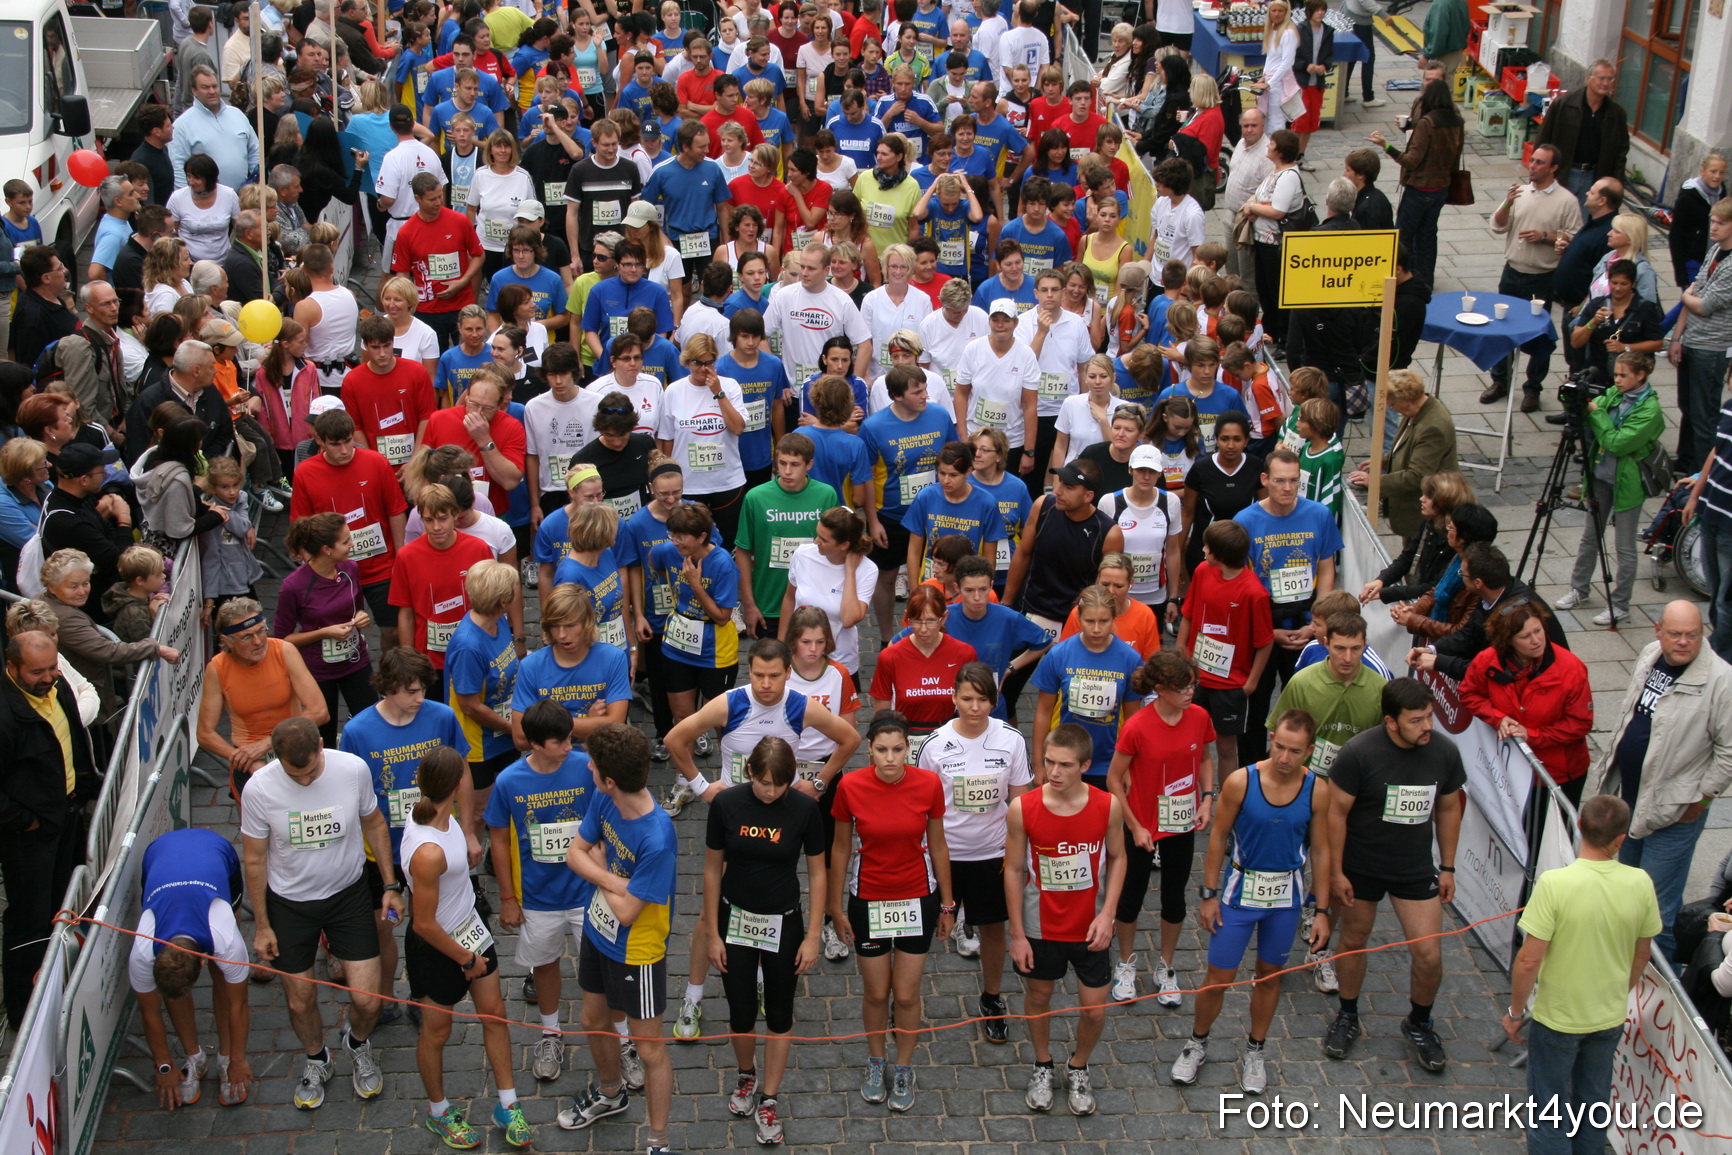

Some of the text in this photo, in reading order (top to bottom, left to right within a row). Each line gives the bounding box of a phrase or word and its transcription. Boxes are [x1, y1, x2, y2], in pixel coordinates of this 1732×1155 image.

[840, 140, 870, 150] HUBER
[600, 209, 619, 218] 5227
[874, 212, 892, 220] 5180
[688, 240, 709, 250] 5145
[438, 263, 458, 272] 5052
[1290, 254, 1387, 270] Schnupper-
[1322, 274, 1354, 288] lauf
[790, 310, 824, 319] GERHART
[1048, 382, 1068, 391] 5174
[749, 412, 763, 421] 167
[984, 410, 1006, 420] 5239
[679, 418, 718, 426] GERHART
[898, 431, 941, 445] NEUMARKTER
[389, 445, 412, 455] 5083
[898, 439, 934, 450] STADTLAUF
[700, 452, 723, 462] 5178
[614, 499, 631, 507] Martin
[618, 504, 640, 518] 5221
[766, 508, 821, 524] Sinupret
[934, 520, 970, 532] STADTLAUF
[938, 514, 980, 526] NEUMARKTER
[353, 528, 374, 539] Andreas
[1254, 532, 1314, 544] 10. NEUMARKTER
[357, 536, 382, 551] 5082
[1264, 538, 1305, 549] STADTLAUF
[996, 550, 1007, 560] 32
[1134, 564, 1156, 573] 5021
[1281, 569, 1307, 578] Bernhard
[595, 581, 618, 600] STADTLAUF
[1284, 578, 1309, 591] 5017
[439, 632, 452, 641] 50
[676, 630, 698, 644] 5128
[1045, 628, 1057, 638] 29
[1204, 638, 1223, 651] Michael
[1203, 650, 1228, 665] 5077
[1076, 668, 1124, 679] NEUMARKTER
[551, 682, 607, 695] NEUMARKTER
[550, 692, 598, 701] STADTLAUF
[1082, 694, 1110, 706] 5191
[1430, 678, 1458, 724] Auftrag!
[383, 738, 442, 756] NEUMARKTER
[966, 778, 998, 786] Katharina
[527, 787, 585, 801] NEUMARKTER
[968, 788, 999, 801] 5202
[1400, 788, 1429, 797] Christian
[527, 797, 574, 809] STADTLAUF
[1400, 800, 1430, 812] 5002
[304, 811, 332, 822] Matthes
[306, 822, 341, 837] 5129
[740, 825, 777, 839] ROXY
[1055, 868, 1087, 880] 5172
[1257, 884, 1288, 896] 5157
[594, 903, 614, 929] 5254
[884, 911, 916, 923] 5015
[461, 924, 484, 950] 5186
[743, 925, 776, 938] 5042
